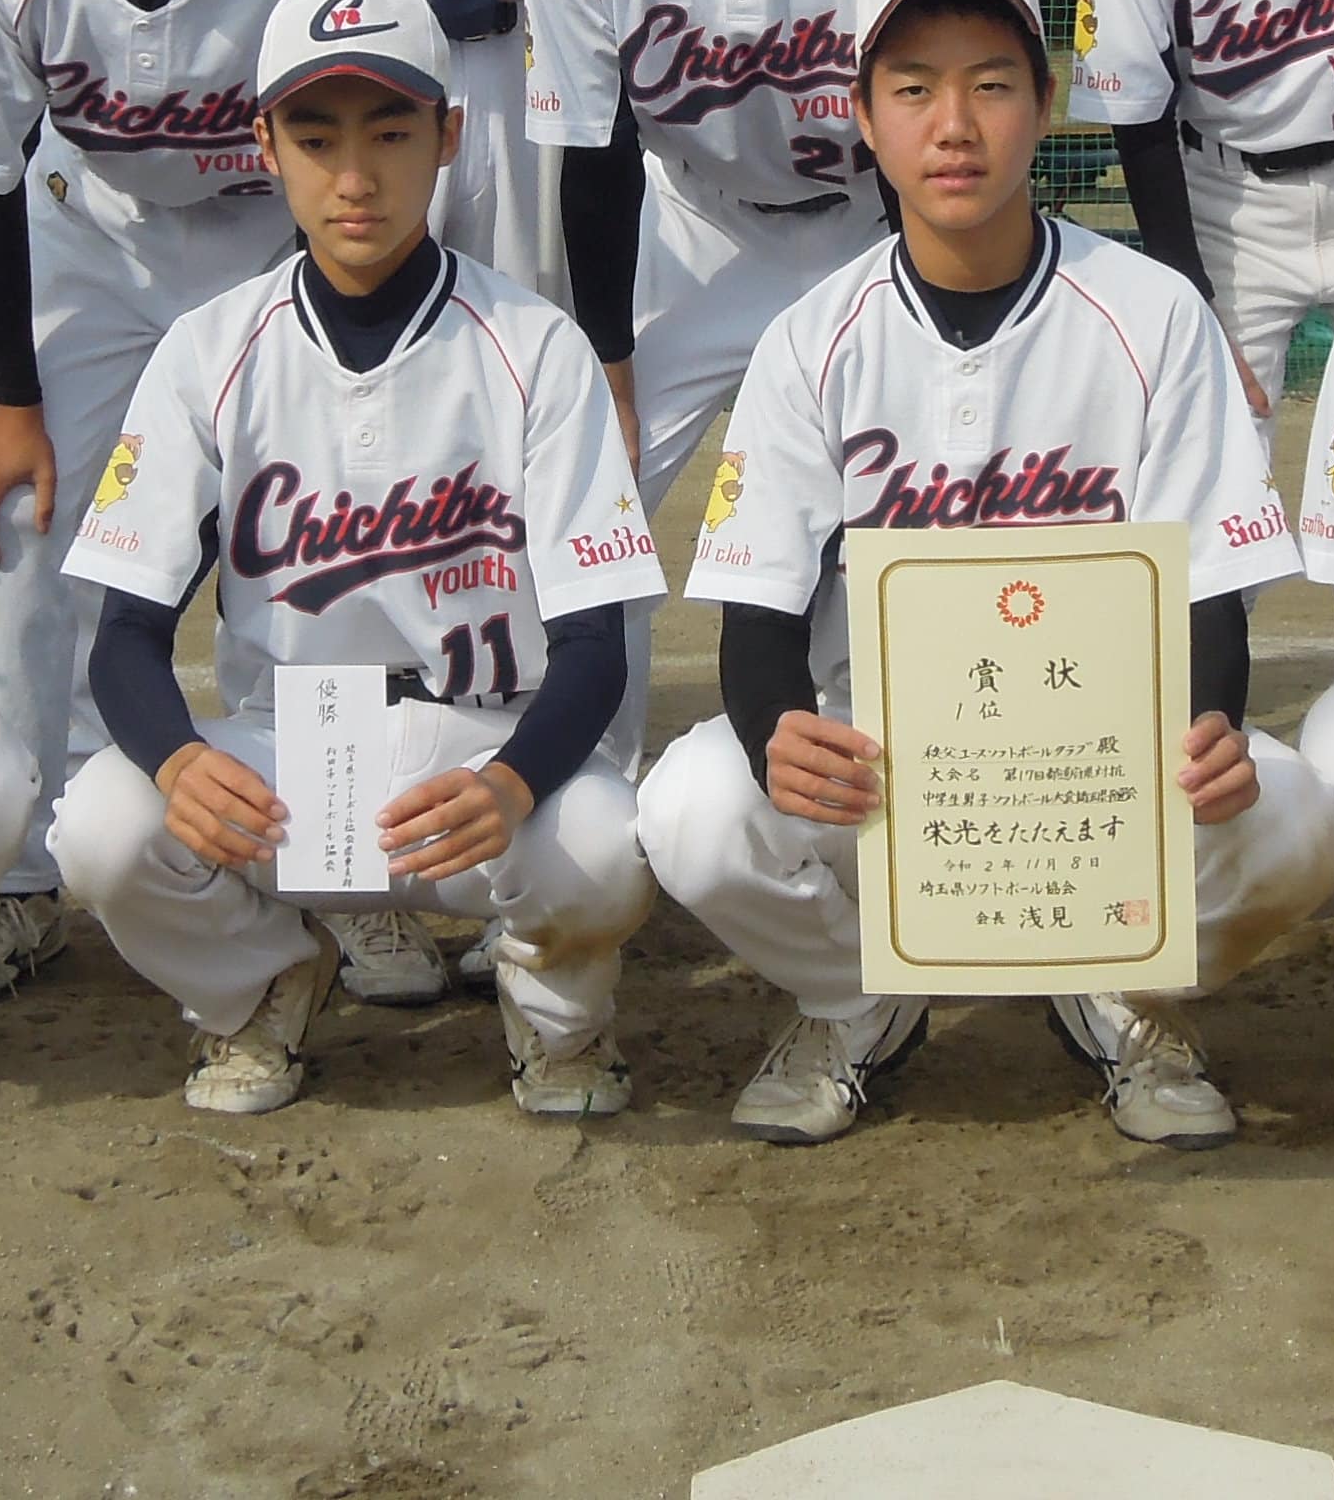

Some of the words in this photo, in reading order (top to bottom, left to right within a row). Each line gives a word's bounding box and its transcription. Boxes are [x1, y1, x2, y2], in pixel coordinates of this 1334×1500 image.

[793, 88, 854, 121] you
[194, 153, 269, 174] yout
[229, 461, 526, 578] Chichibu
[568, 526, 653, 568] Saita
[423, 568, 517, 611] youth
[441, 614, 518, 696] 11
[316, 678, 340, 727] 優勝
[922, 816, 1126, 847] 栄光をたたえます
[919, 879, 1077, 897] 埼玉県ソフトボール協会
